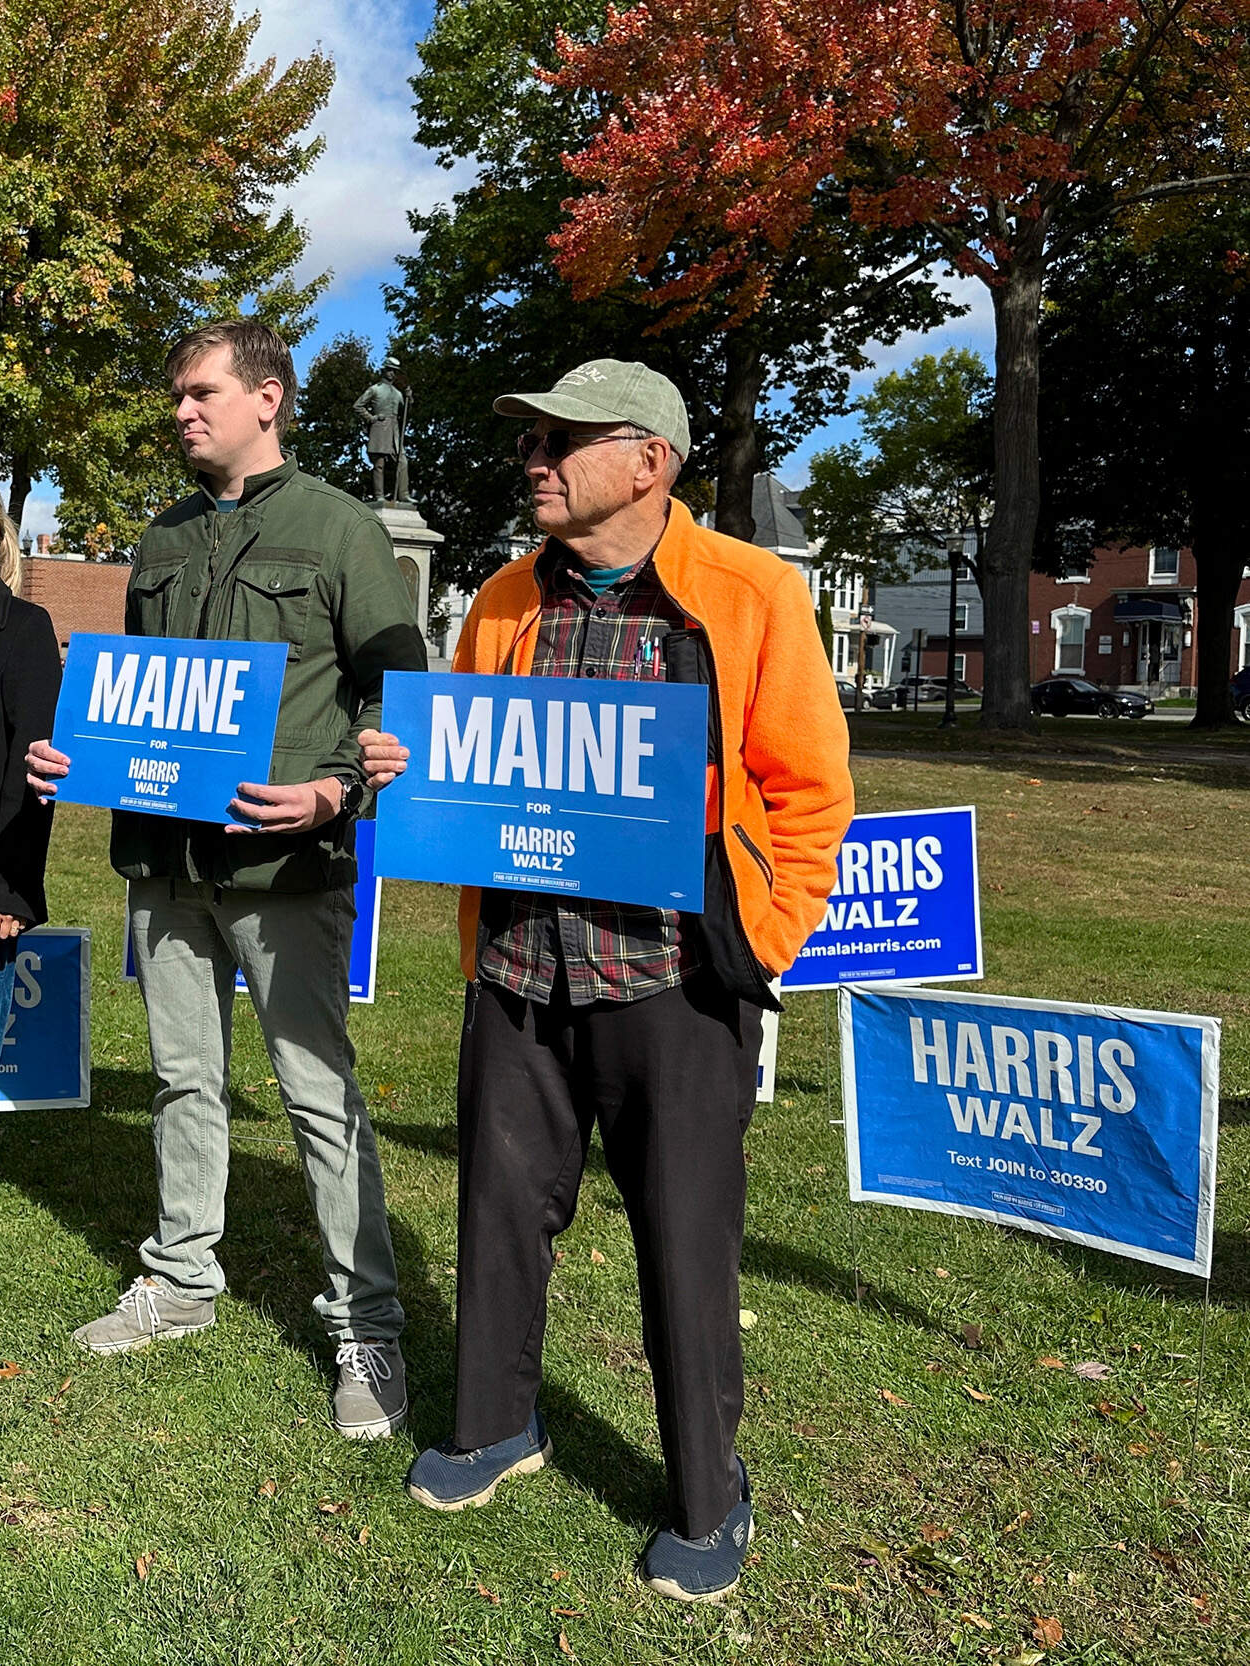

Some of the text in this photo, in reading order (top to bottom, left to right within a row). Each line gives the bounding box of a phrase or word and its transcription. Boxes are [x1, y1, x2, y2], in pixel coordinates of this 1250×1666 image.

[87, 651, 251, 736] MAINE
[150, 739, 168, 750] FOR
[428, 694, 657, 800] MAINE
[128, 757, 181, 784] HARRIS
[135, 781, 170, 797] WALZ
[526, 802, 551, 815] FOR
[500, 824, 576, 857] HARRIS
[512, 853, 564, 872] WALZ
[830, 835, 944, 896] RRIS
[797, 938, 942, 958] amalaHarris.com
[909, 1016, 1137, 1114] HARRIS
[946, 1093, 1103, 1158] WALZ
[947, 1150, 1108, 1194] Text JOIN to 30330
